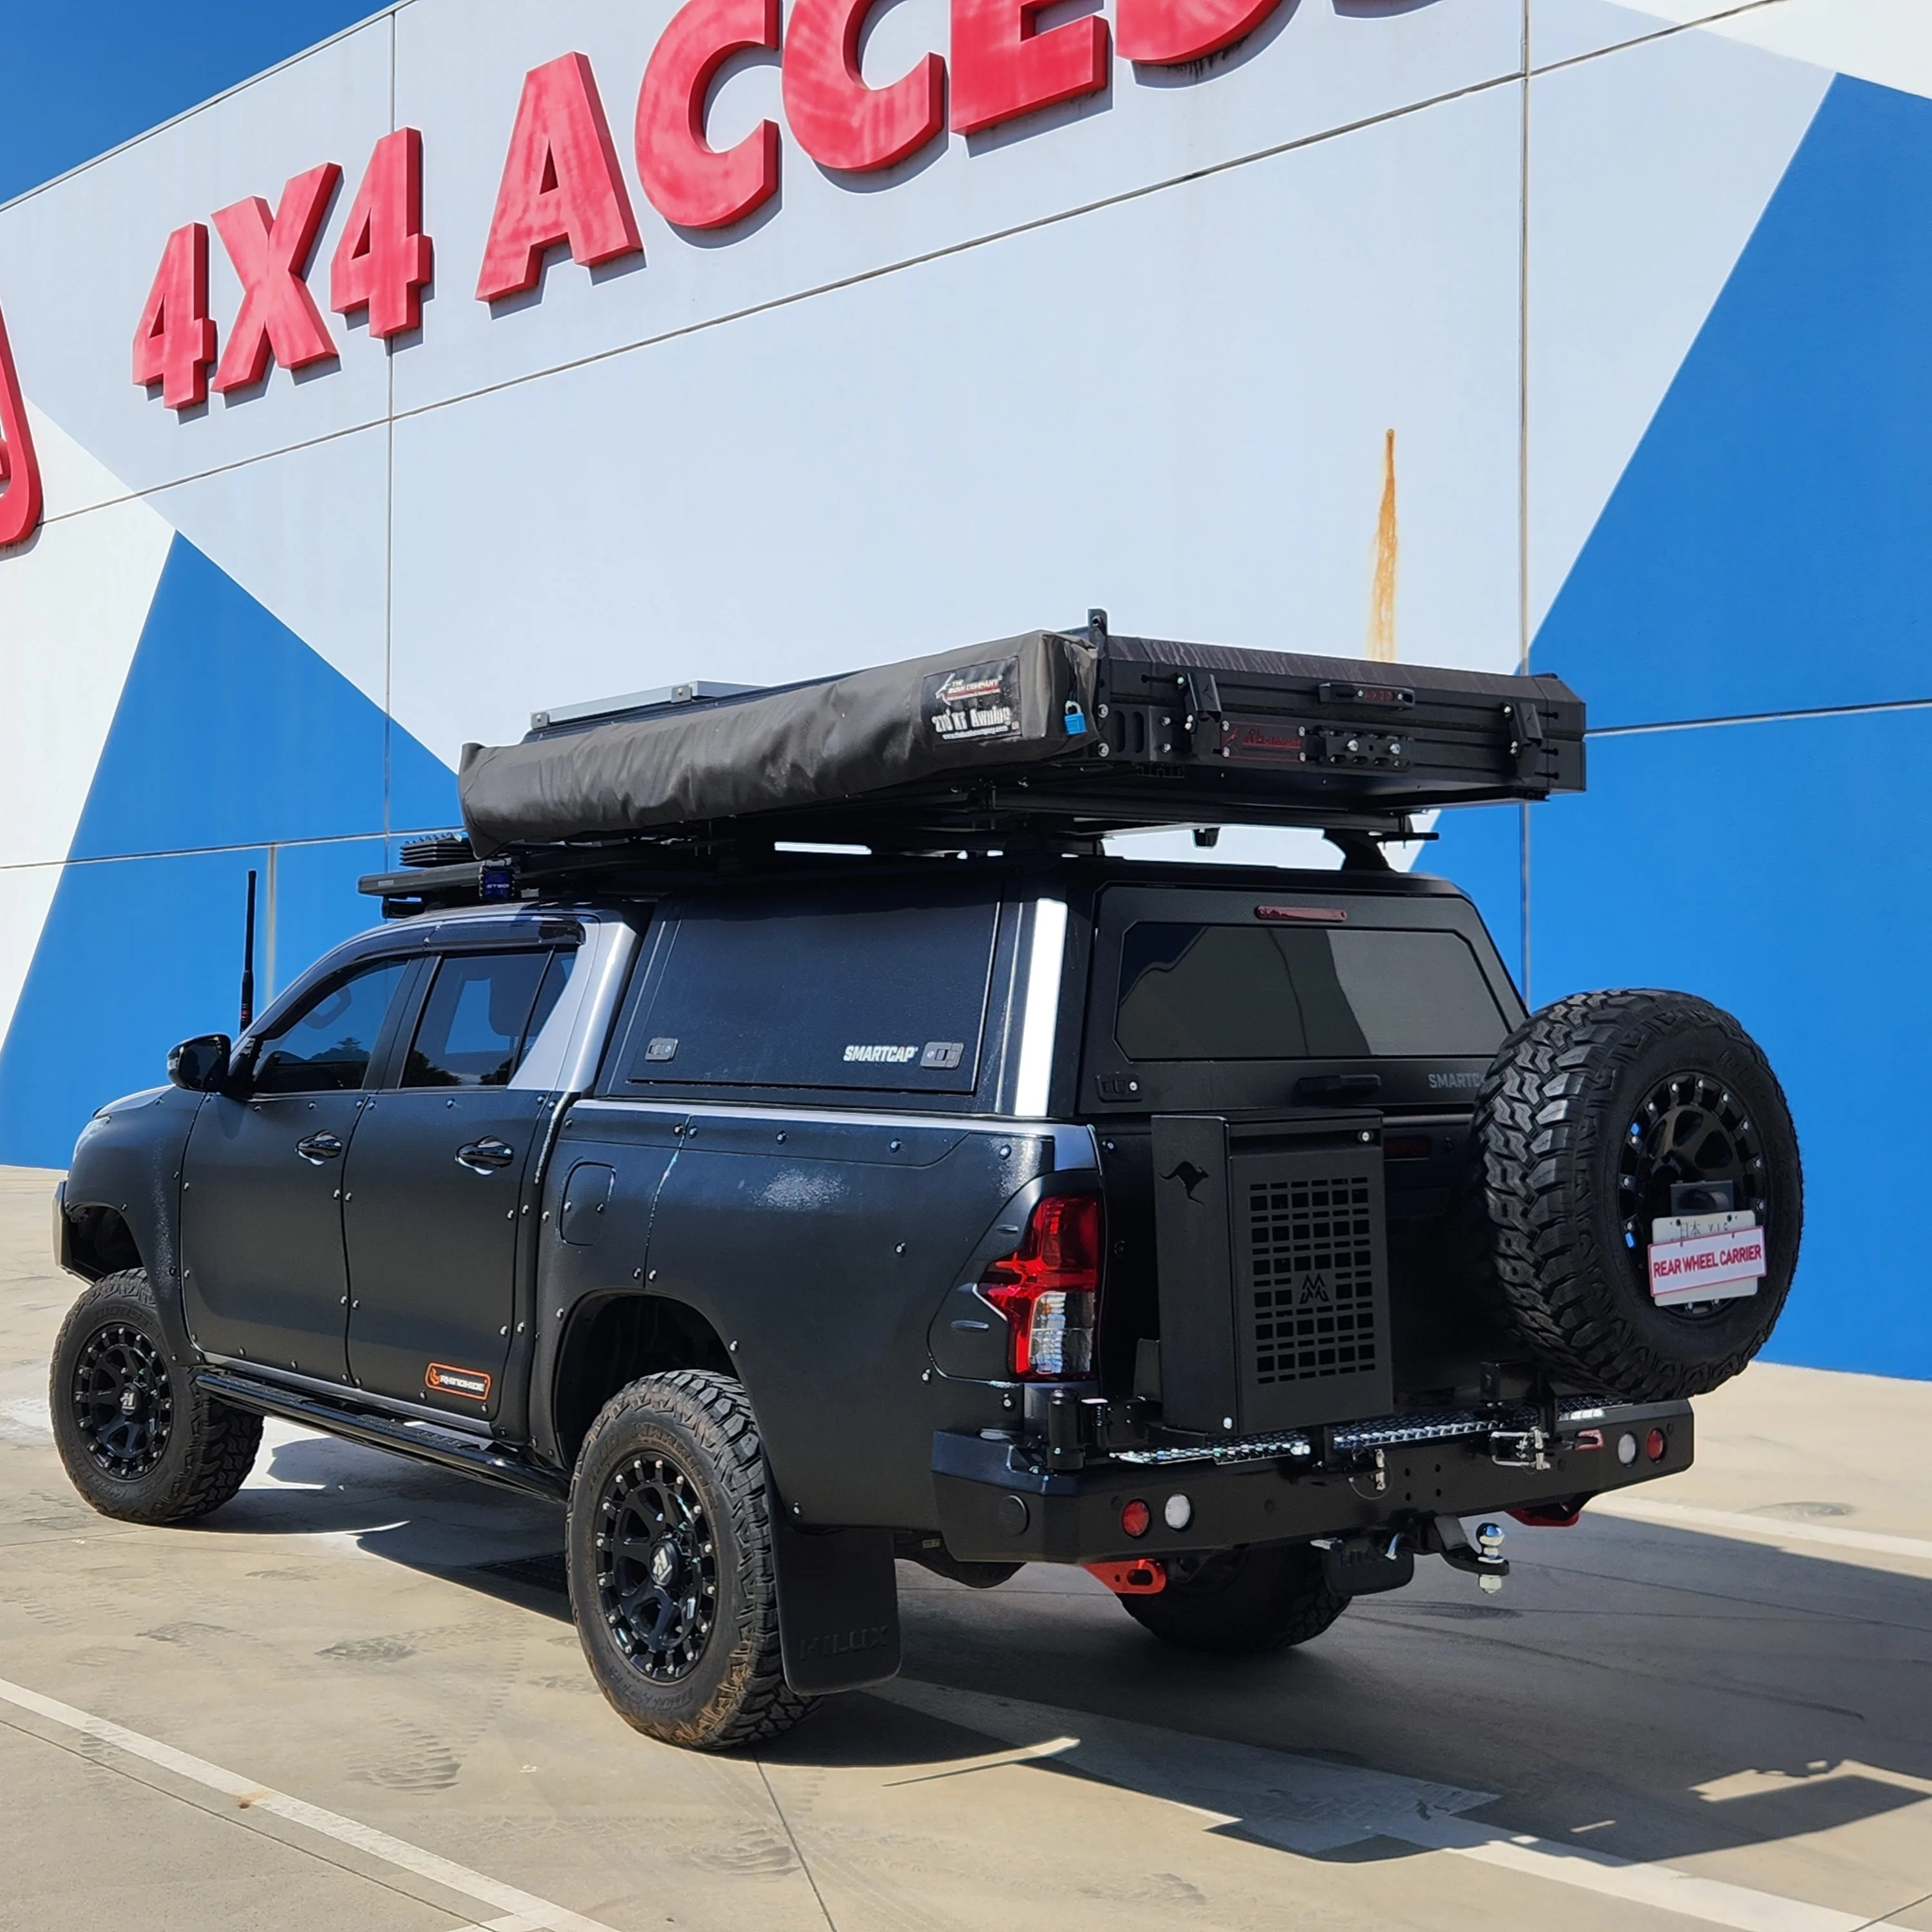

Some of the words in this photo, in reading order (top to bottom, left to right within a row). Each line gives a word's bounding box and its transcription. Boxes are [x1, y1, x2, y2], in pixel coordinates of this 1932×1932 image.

[133, 127, 432, 410] 4X4
[475, 0, 1288, 303] ACCE
[843, 1045, 916, 1063] SMARTCAP
[1428, 1073, 1481, 1088] SMARTC
[1653, 1258, 1682, 1278] REAR
[1682, 1251, 1719, 1273] WHEEL
[1719, 1244, 1762, 1266] CARRIER
